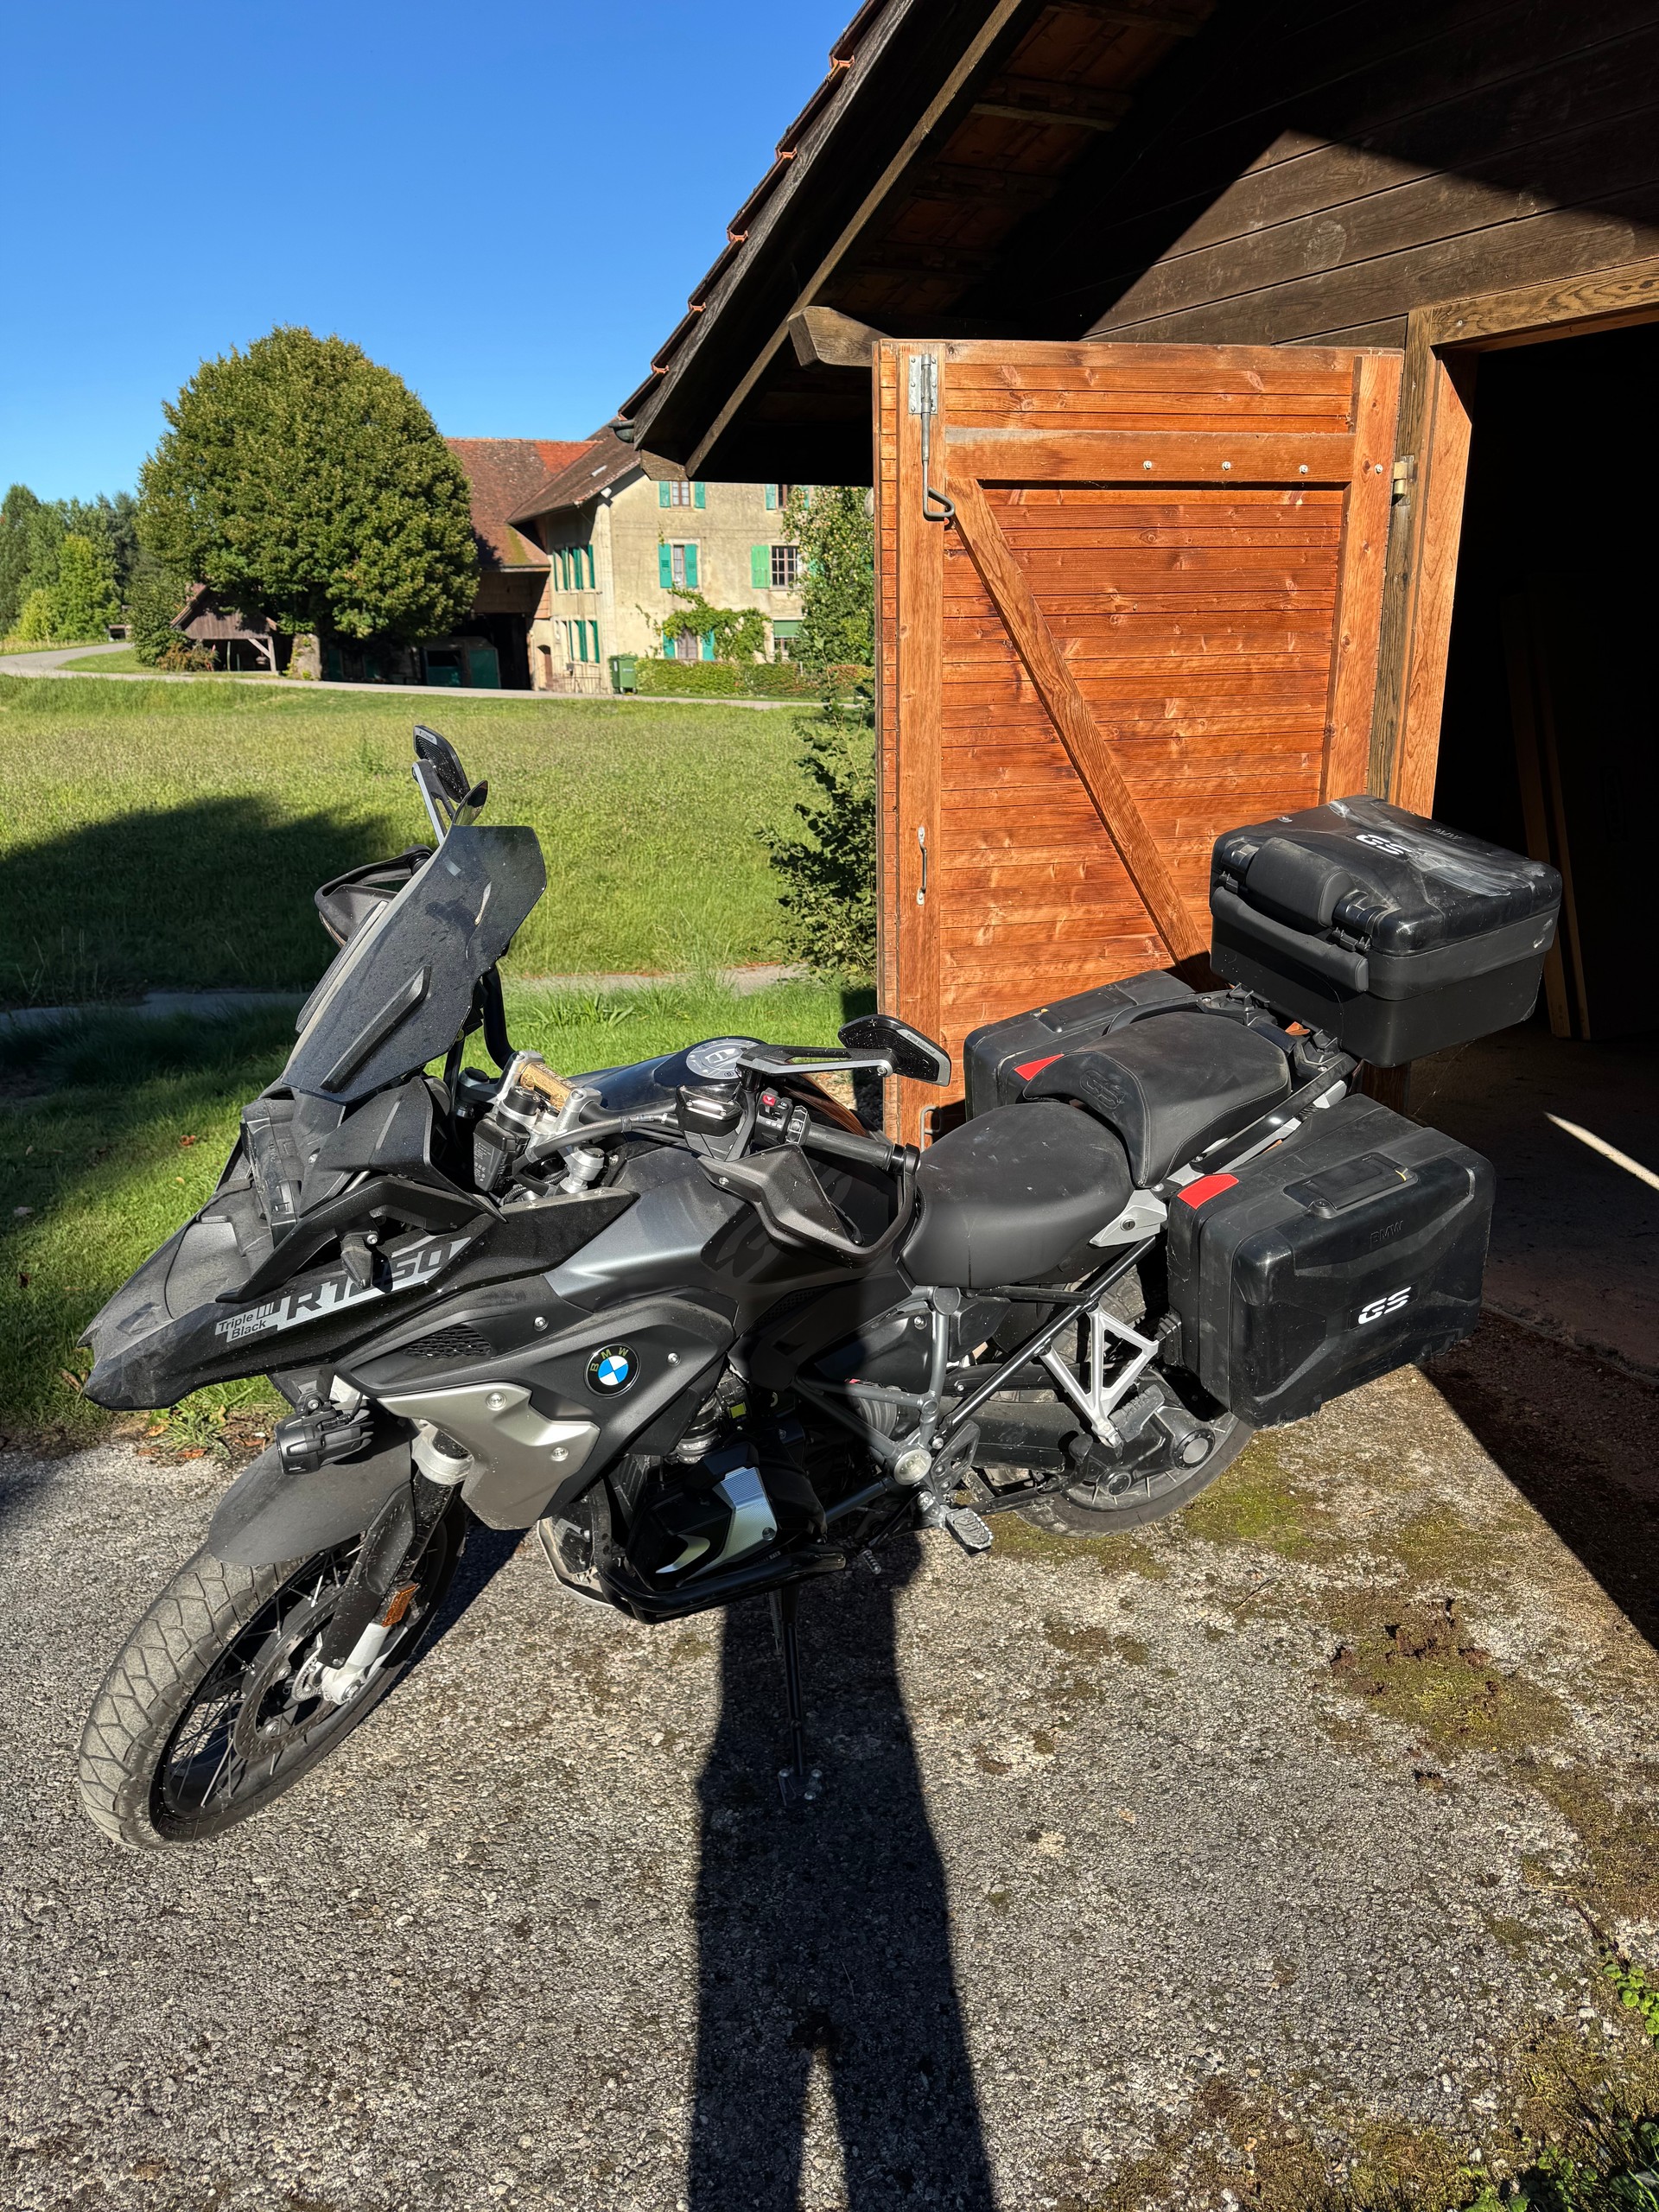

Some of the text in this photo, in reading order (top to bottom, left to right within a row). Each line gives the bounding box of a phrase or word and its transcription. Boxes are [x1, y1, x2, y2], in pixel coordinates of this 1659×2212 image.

[1356, 835, 1413, 855] GS
[1370, 1219, 1404, 1245] BMW
[1358, 1287, 1412, 1324] GS
[219, 1313, 253, 1332] Triple
[231, 1319, 266, 1339] Black
[590, 1347, 629, 1371] BMW
